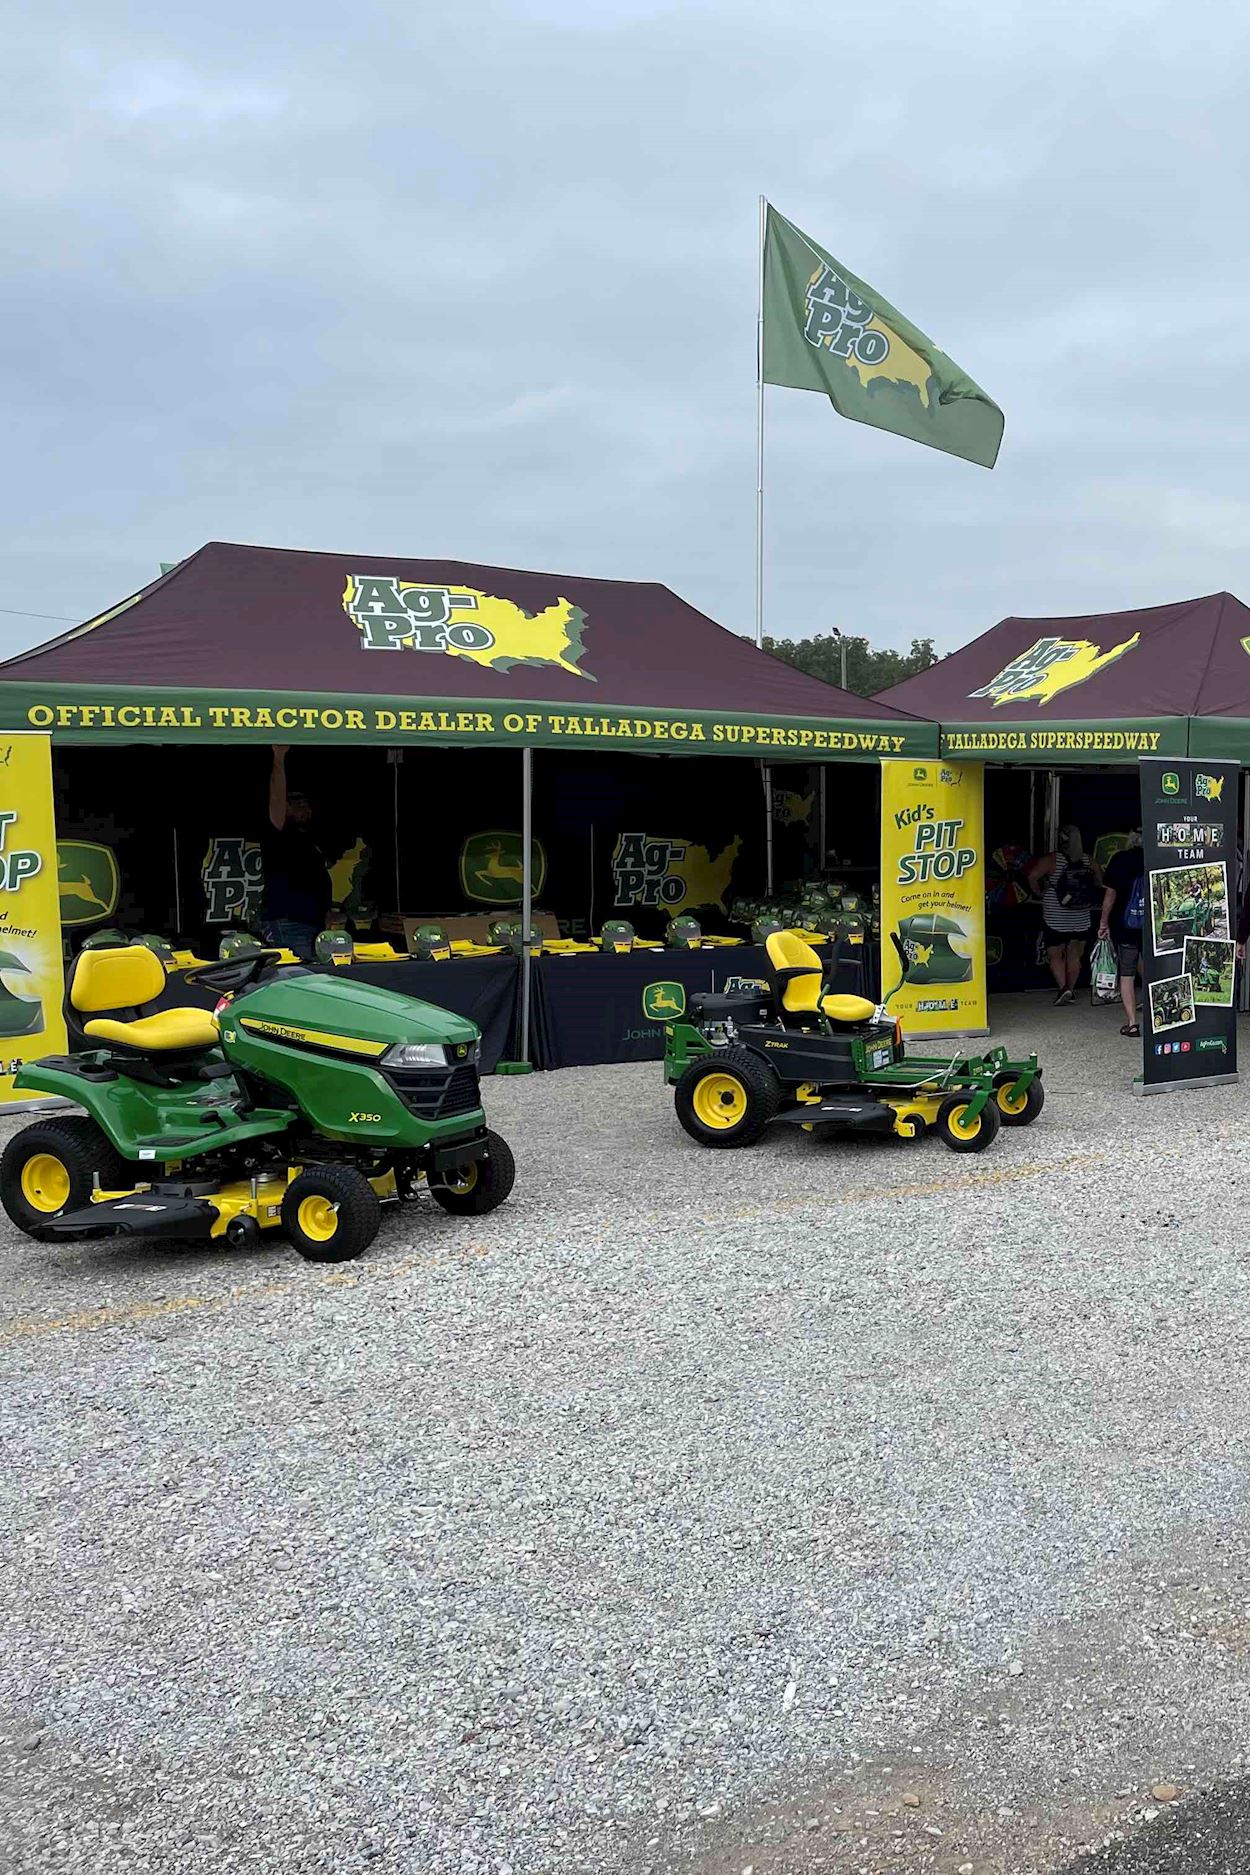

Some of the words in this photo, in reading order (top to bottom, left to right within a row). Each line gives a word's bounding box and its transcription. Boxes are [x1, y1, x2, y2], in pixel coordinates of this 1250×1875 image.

[807, 264, 873, 324] Ag
[804, 300, 889, 365] Pro
[350, 575, 478, 622] Ag-
[360, 612, 495, 651] Pro
[966, 670, 1049, 698] Pro
[27, 704, 201, 727] OFFICIAL
[209, 707, 367, 730] TRACTOR
[376, 710, 494, 732] DEALER
[504, 714, 543, 734] OF
[549, 716, 706, 741] TALLADEGA
[713, 725, 905, 753] SUPERSPEEDWAY
[948, 733, 1026, 749] TALLADEGA
[1030, 732, 1160, 750] SUPERSPEEDWAY
[894, 804, 935, 829] Kid's
[915, 819, 963, 852] PIT
[1161, 828, 1218, 842] HOME
[613, 833, 685, 877] Ag-
[897, 848, 976, 884] STOP
[1178, 849, 1204, 859] TEAM
[613, 871, 687, 906] Pro
[901, 893, 920, 903] Come
[918, 901, 929, 910] get
[947, 901, 972, 912] helmet!
[259, 1022, 278, 1035] JOHN
[279, 1026, 306, 1040] DEERE
[349, 1112, 381, 1123] X350
